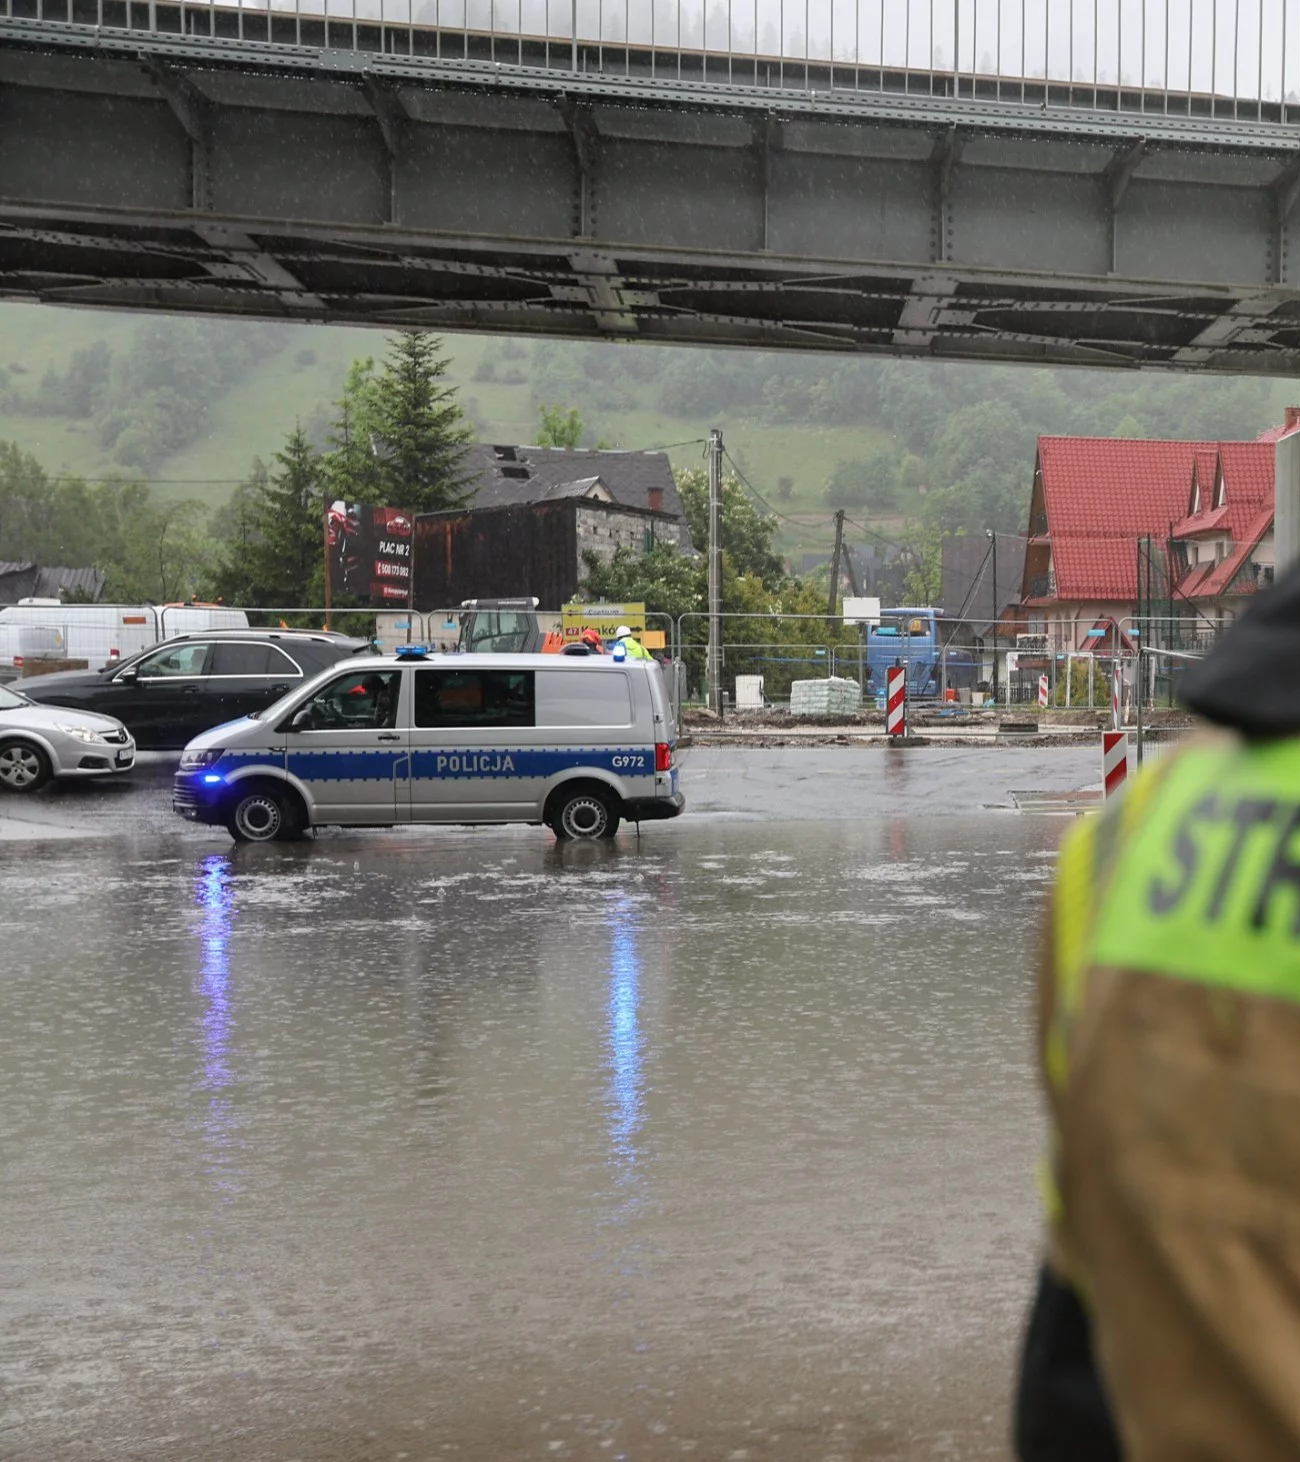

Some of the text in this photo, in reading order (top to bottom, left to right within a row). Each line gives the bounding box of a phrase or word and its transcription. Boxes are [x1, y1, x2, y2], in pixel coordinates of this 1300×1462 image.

[379, 541, 410, 556] PLAC NR 2
[436, 755, 515, 772] POLICJA
[611, 756, 645, 768] G972
